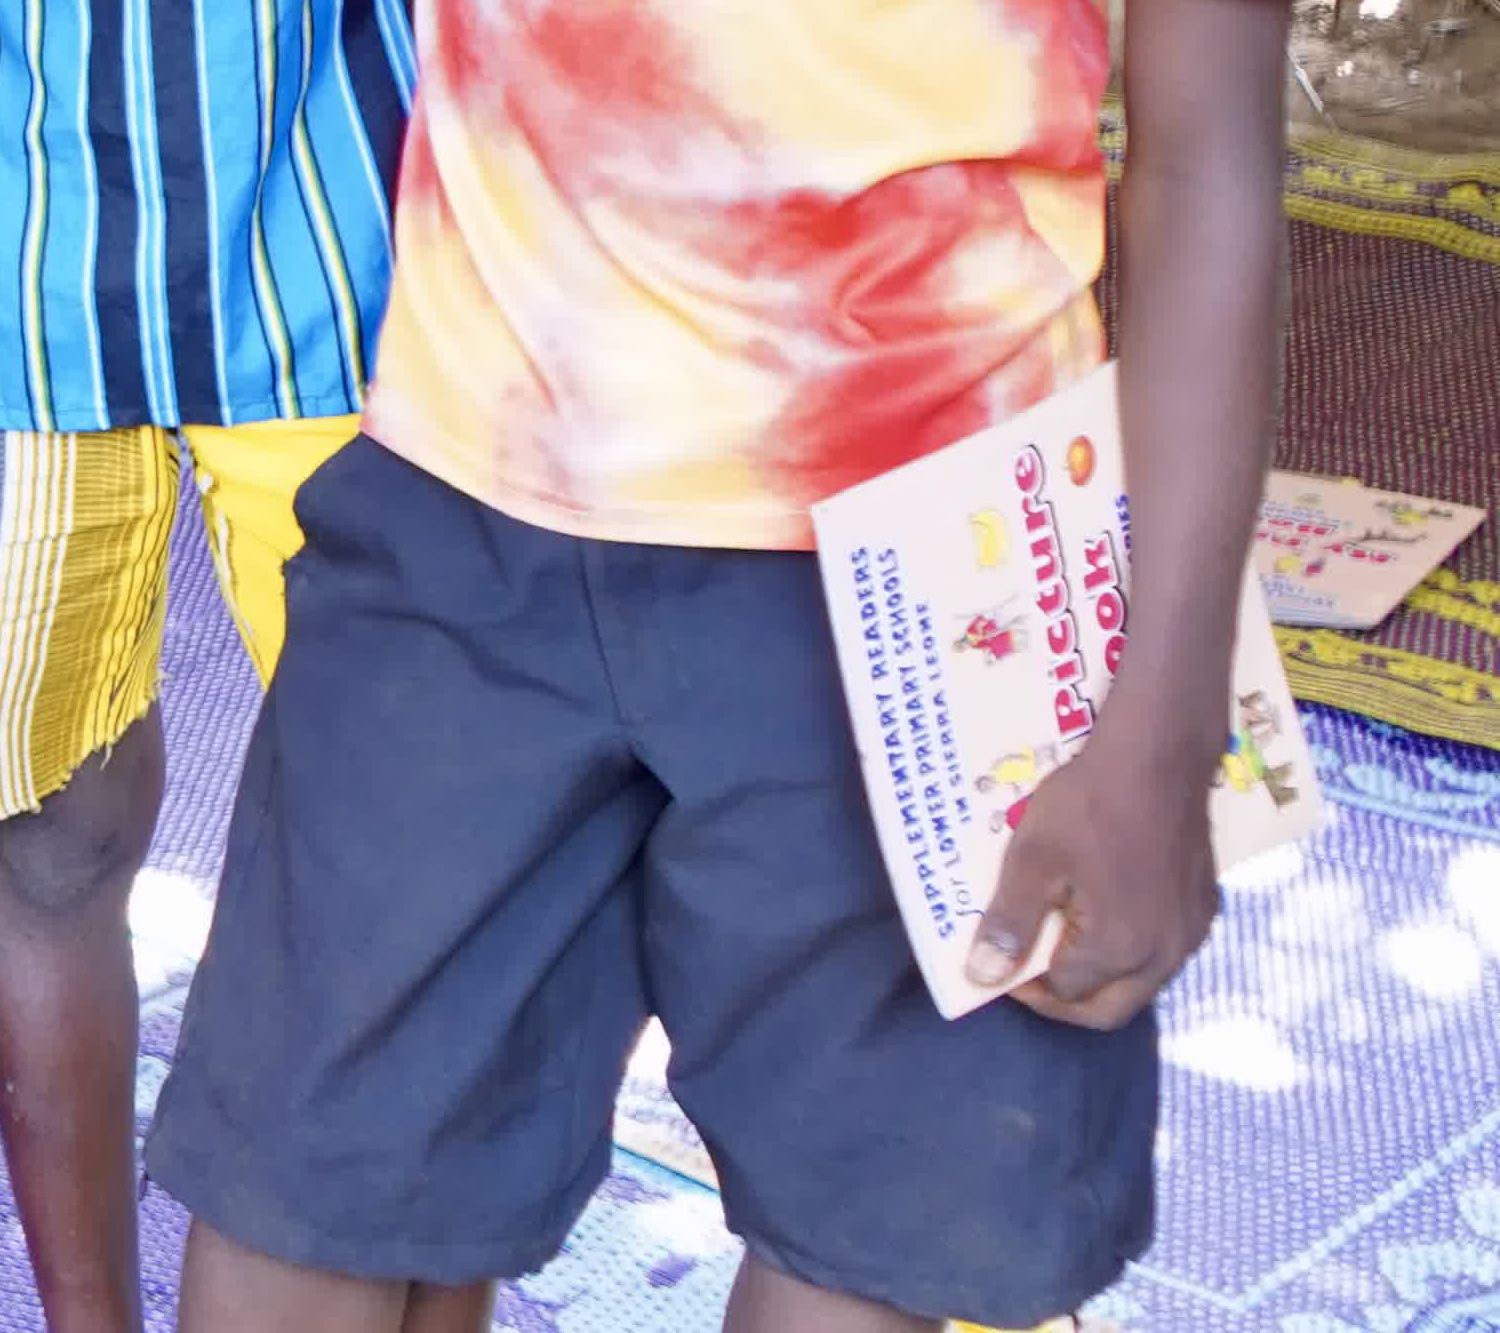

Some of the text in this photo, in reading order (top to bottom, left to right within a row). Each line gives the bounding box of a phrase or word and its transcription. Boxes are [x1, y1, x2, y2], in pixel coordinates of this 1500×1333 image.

[877, 546, 987, 918] for LOWER PRIMARY SCHOOLS
[914, 600, 973, 826] IN SIERRA LEONE
[1014, 445, 1095, 740] Picture
[1082, 530, 1129, 681] ook
[850, 546, 957, 941] SUPPLEMENTARY READERS
